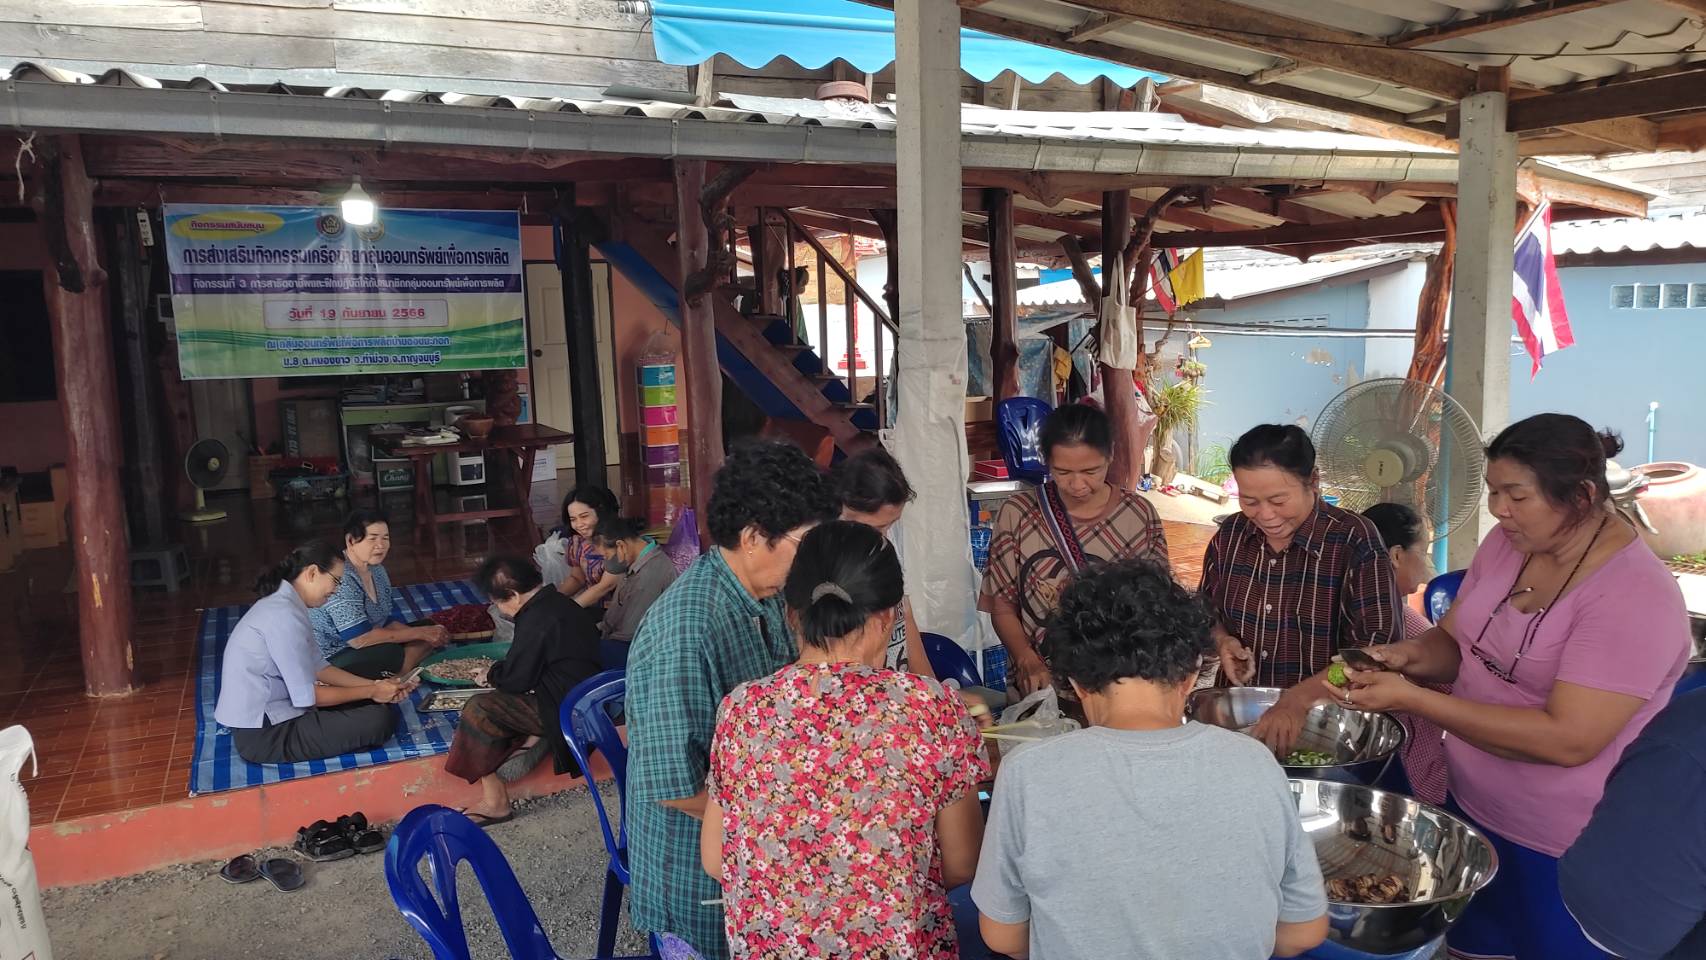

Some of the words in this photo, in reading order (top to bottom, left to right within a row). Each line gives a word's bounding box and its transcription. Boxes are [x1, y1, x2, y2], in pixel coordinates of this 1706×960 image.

[193, 276, 236, 289] กิจกรรมที่
[239, 279, 247, 288] 3
[289, 306, 313, 319] วันที่
[320, 309, 336, 319] 19
[342, 308, 387, 319] กันยายน
[392, 308, 425, 318] 2566
[391, 351, 441, 366] จ.กาญจนบุรี
